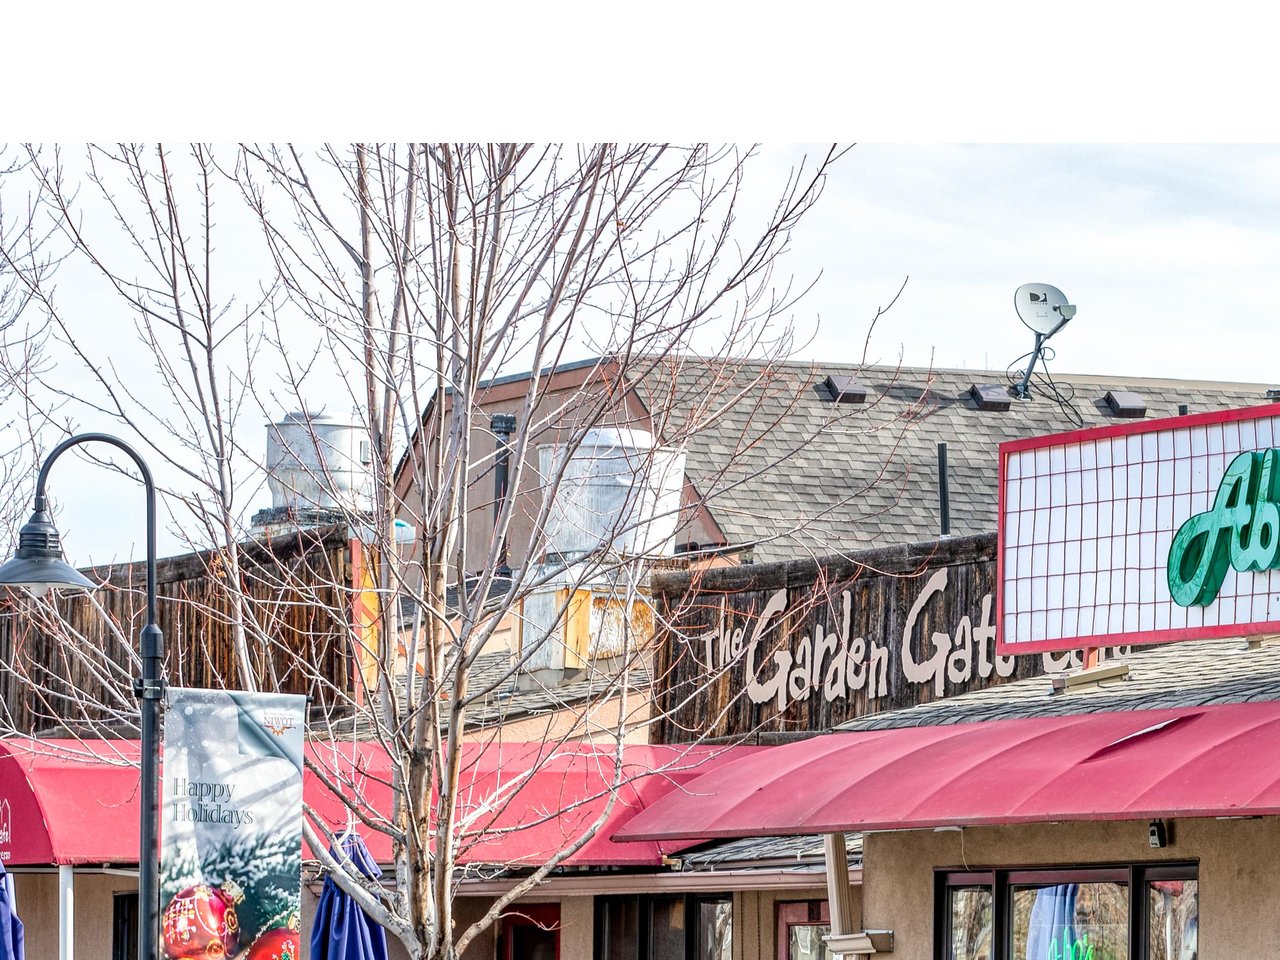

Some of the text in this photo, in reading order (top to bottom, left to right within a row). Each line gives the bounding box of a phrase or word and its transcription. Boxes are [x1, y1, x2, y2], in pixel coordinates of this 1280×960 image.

[703, 596, 742, 672] The
[746, 589, 889, 711] Garden
[173, 777, 235, 803] Happy
[173, 803, 254, 829] Holidays
